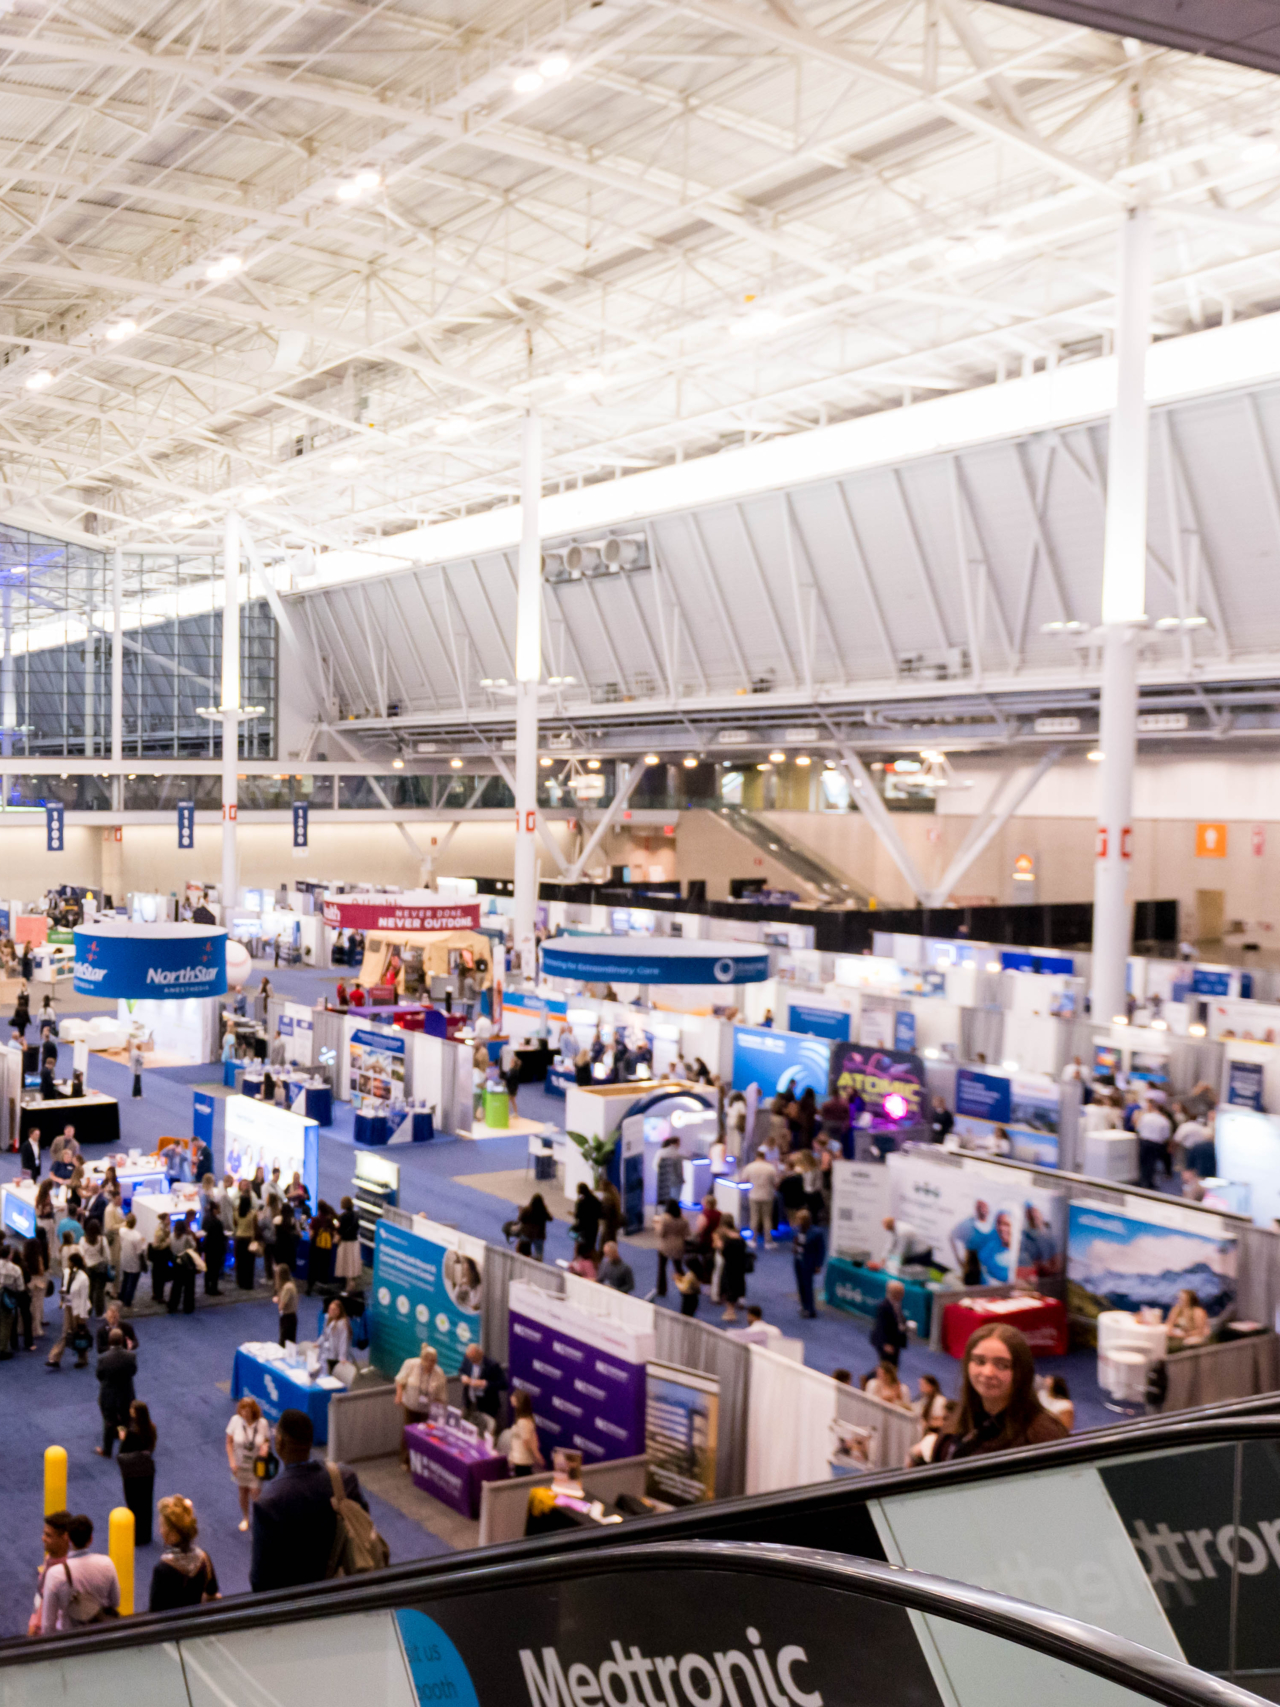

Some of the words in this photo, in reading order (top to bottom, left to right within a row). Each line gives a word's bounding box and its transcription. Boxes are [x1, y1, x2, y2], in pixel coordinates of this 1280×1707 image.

[181, 809, 190, 846] 1100
[378, 917, 421, 928] NEVER
[424, 916, 473, 928] OUTDONE.
[395, 909, 432, 917] NEVER
[146, 965, 219, 984] NorthStar
[518, 1625, 823, 1707] Medtronic
